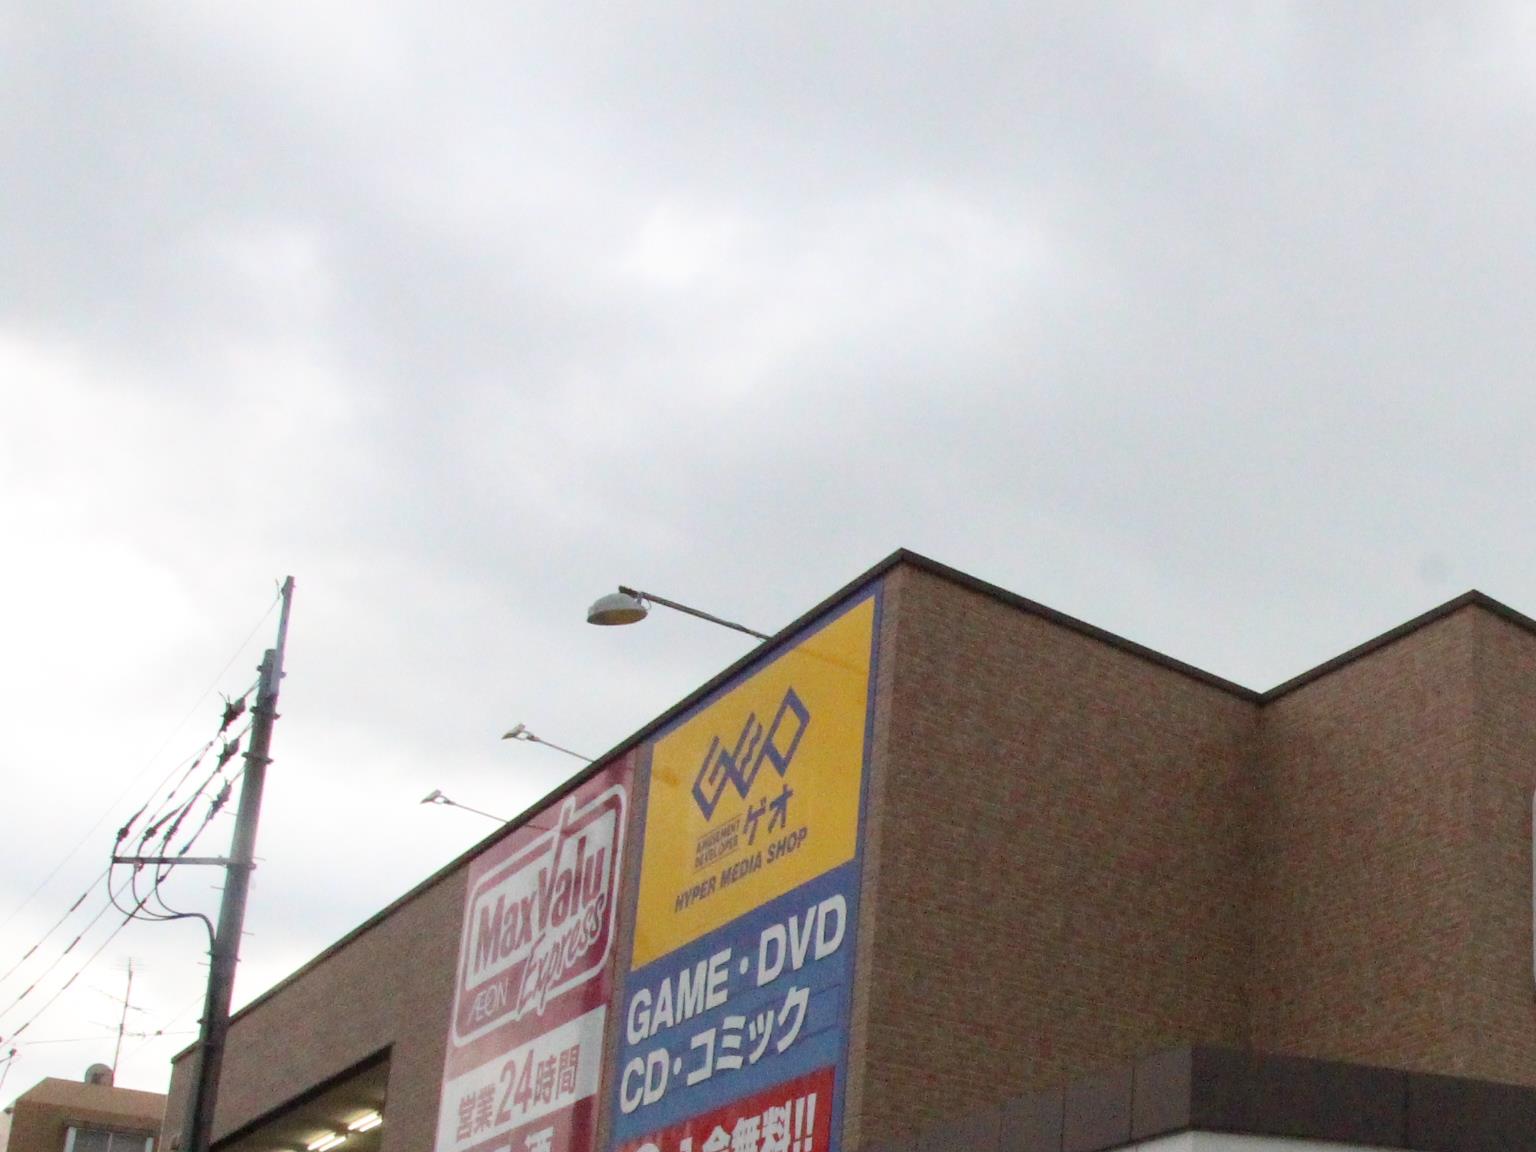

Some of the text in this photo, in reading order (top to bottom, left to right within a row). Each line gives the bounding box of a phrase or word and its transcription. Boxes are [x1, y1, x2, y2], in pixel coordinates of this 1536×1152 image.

[743, 784, 794, 846] ゲオ
[476, 803, 605, 974] MaxValu
[675, 827, 808, 913] HYPER MEDIA SHOP
[517, 893, 605, 1013] Express
[458, 1046, 578, 1140] 営業24時間
